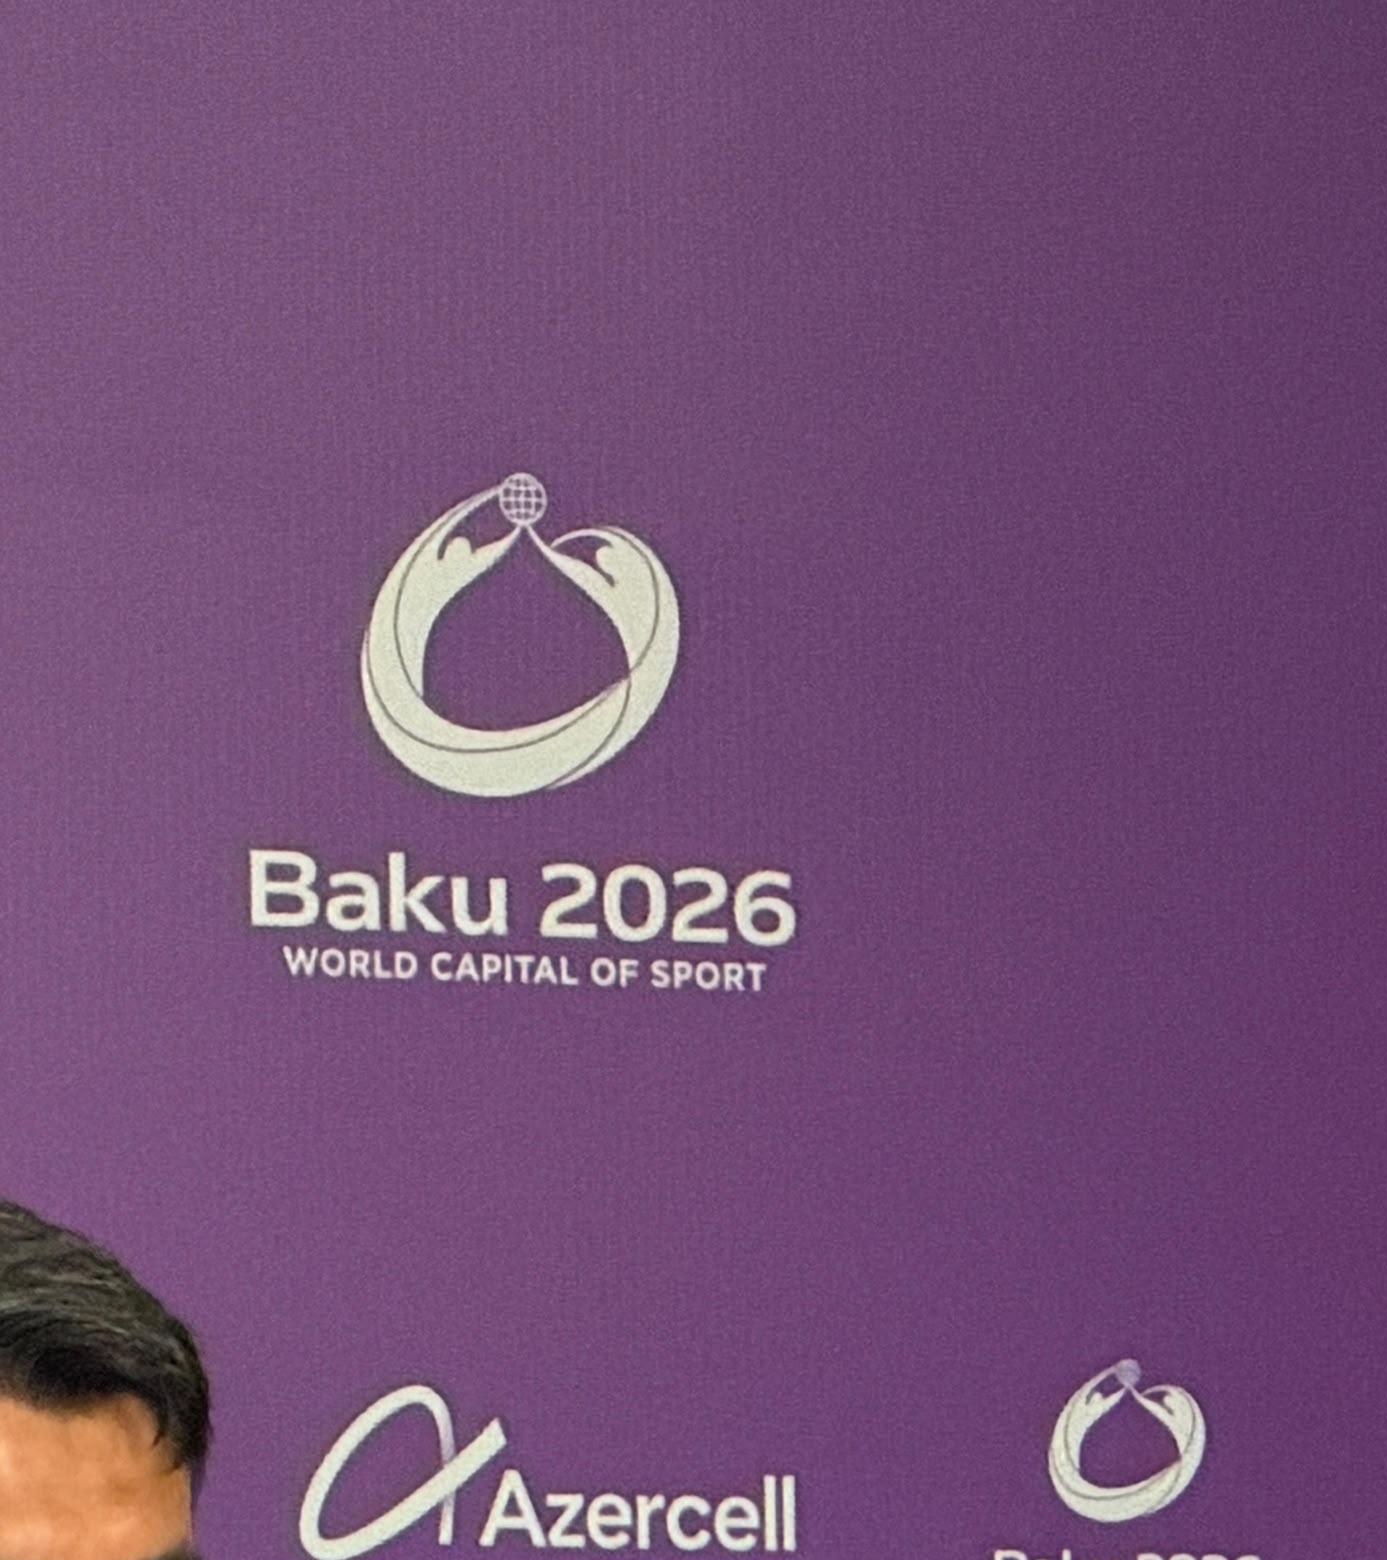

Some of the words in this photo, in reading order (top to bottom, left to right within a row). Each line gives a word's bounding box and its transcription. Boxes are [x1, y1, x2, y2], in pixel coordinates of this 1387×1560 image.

[249, 849, 508, 936] Baku
[540, 863, 797, 947] 2026
[282, 945, 418, 980] WORLD
[430, 951, 579, 986] CAPITAL
[590, 957, 639, 988] OF
[650, 959, 767, 992] SPORT
[478, 1469, 797, 1552] Azercell
